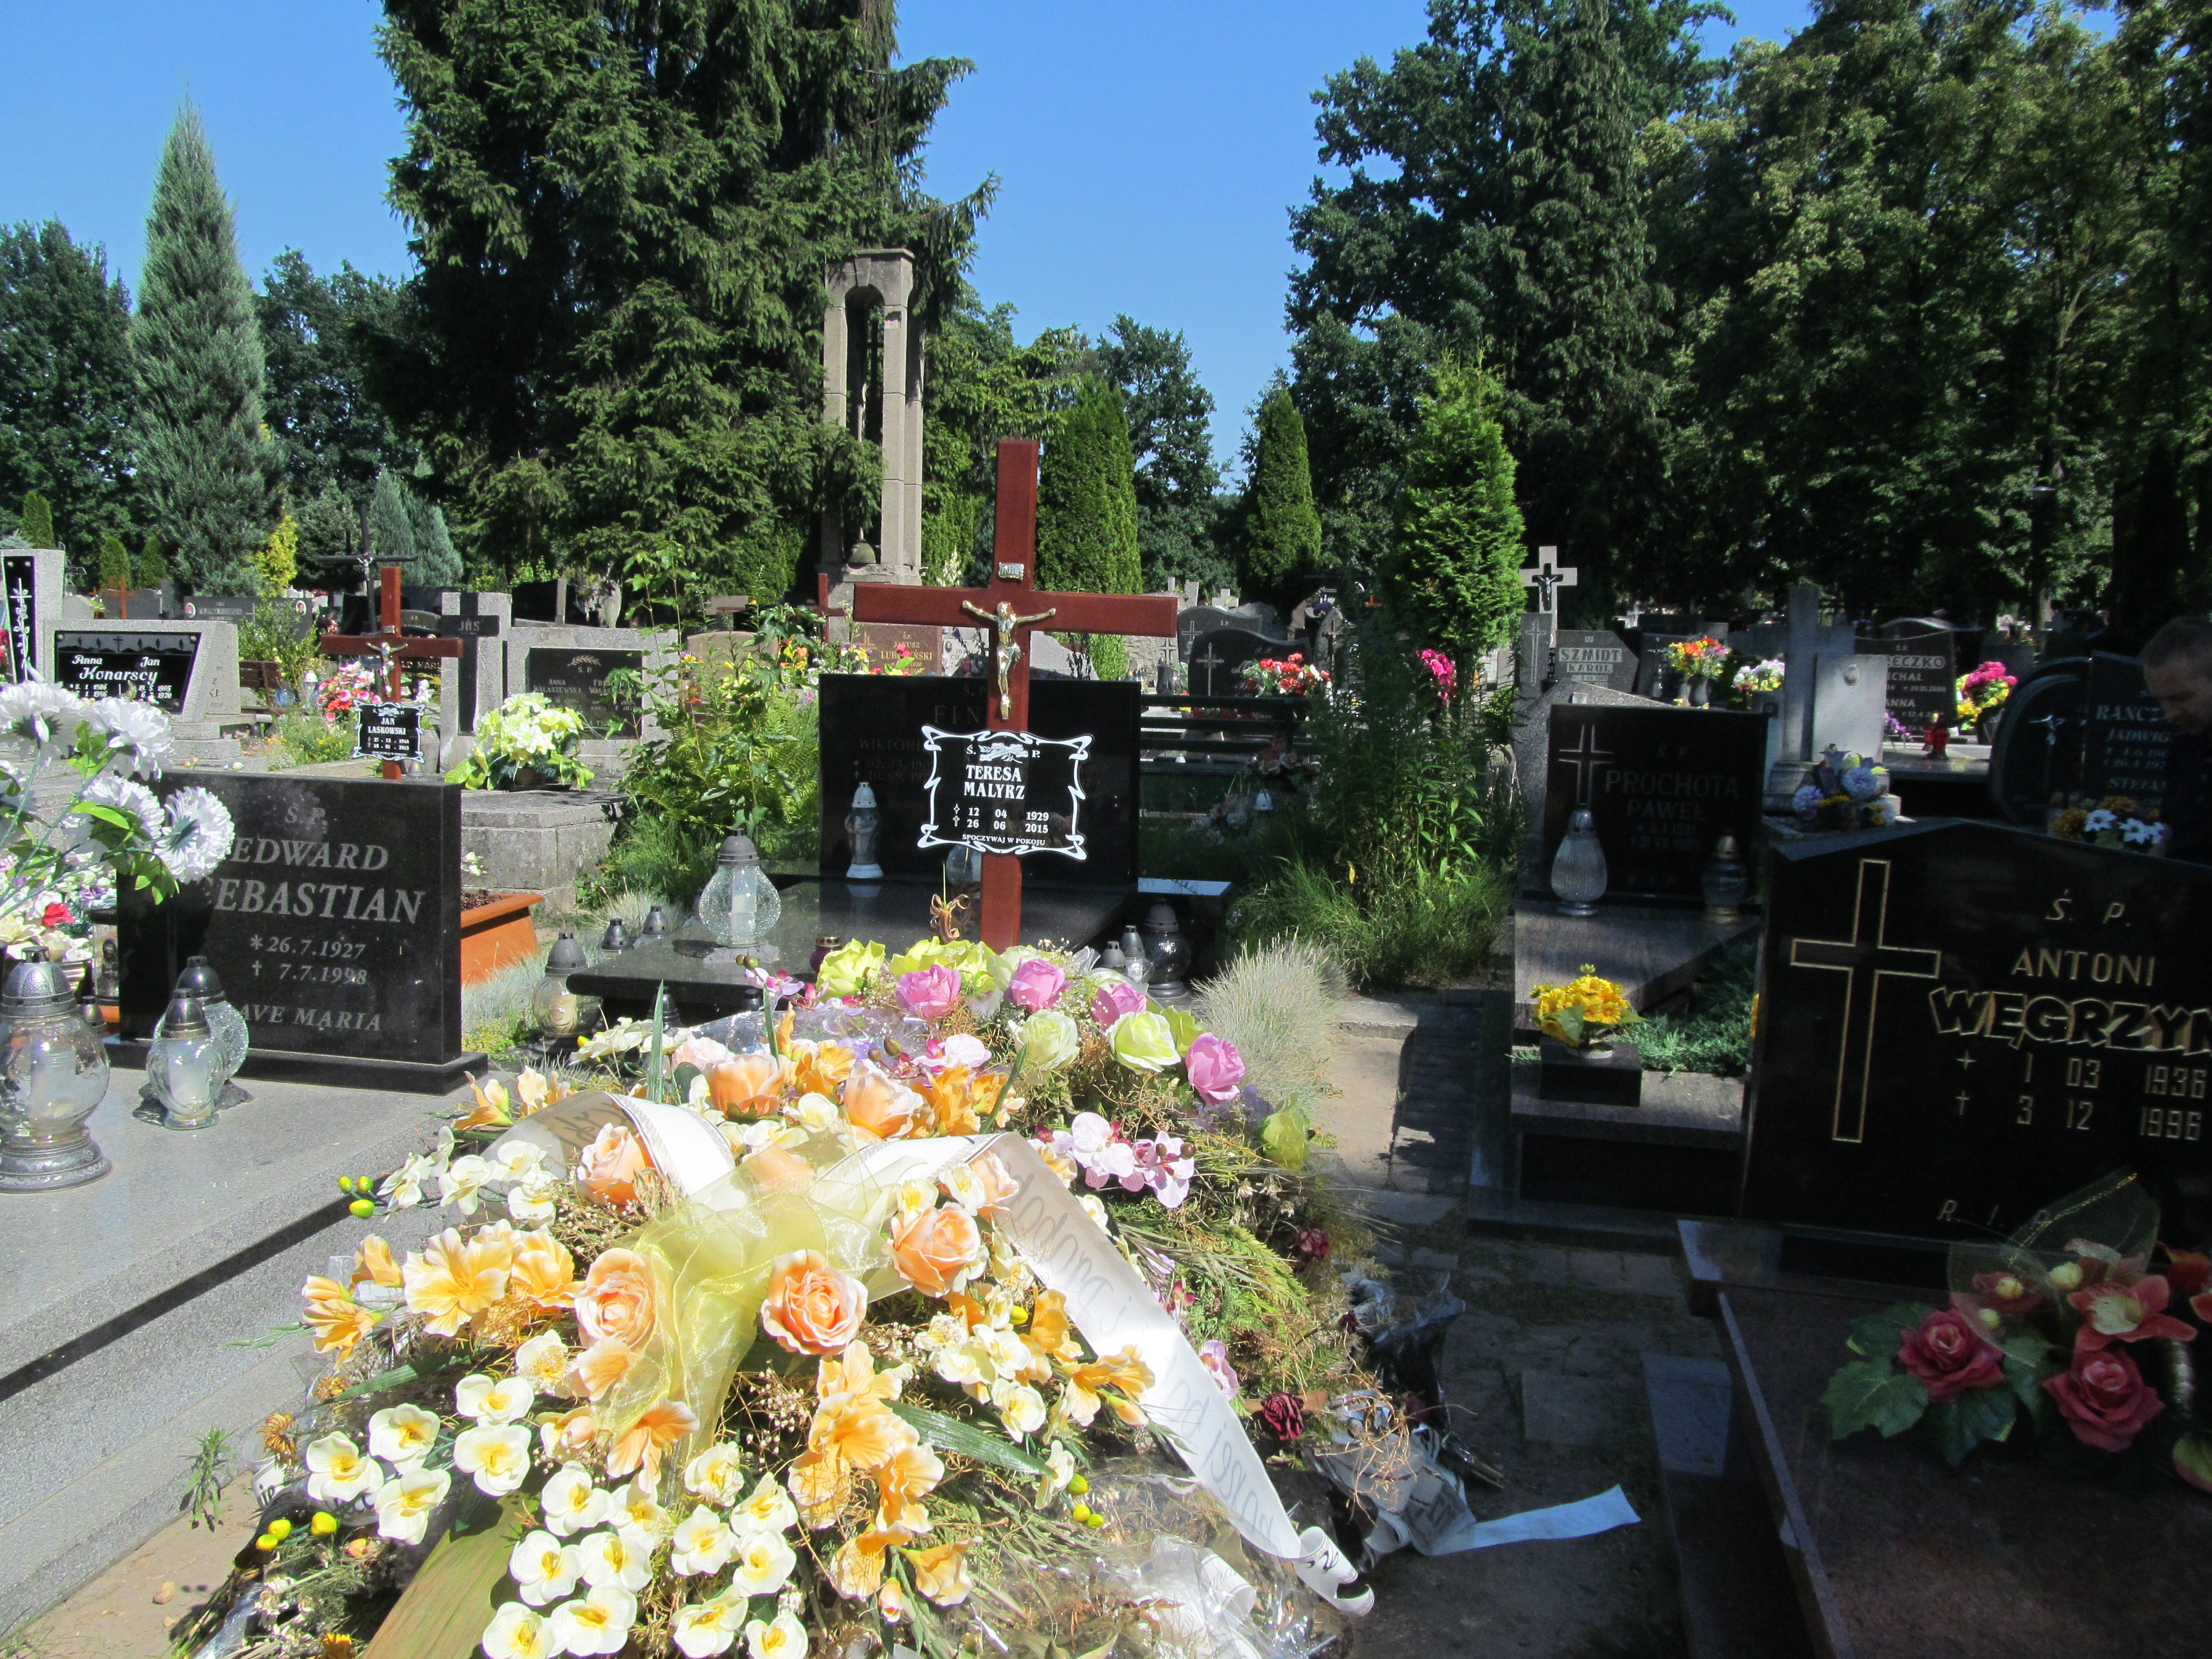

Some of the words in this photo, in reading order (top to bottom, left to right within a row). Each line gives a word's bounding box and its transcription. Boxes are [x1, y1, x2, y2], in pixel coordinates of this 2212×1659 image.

[72, 654, 103, 665] Anna
[140, 656, 160, 667] Jan
[79, 666, 159, 685] Konarscy
[380, 717, 395, 726] JAN
[934, 705, 980, 724] FIN
[859, 738, 921, 752] WIKTORI
[2105, 728, 2173, 743] JADWIG
[966, 745, 976, 755] Ś.
[1032, 750, 1040, 758] P.
[965, 764, 1022, 782] TERESA
[963, 781, 1026, 800] MALYRZ
[1605, 770, 1738, 799] PROCHOTA
[968, 807, 980, 817] 12
[995, 809, 1008, 818] 04
[1026, 811, 1049, 821] 1929
[967, 819, 980, 828] 26
[993, 820, 1006, 831] 06
[1025, 823, 1049, 834] 2015
[962, 834, 1006, 844] SPOCZYWAJ
[1015, 838, 1046, 846] POKOJU
[230, 837, 389, 871] EDWARD
[2103, 902, 2132, 926] P.
[266, 936, 367, 960] 26.7.1927
[2011, 947, 2156, 986] ANTONI
[240, 1003, 285, 1023] AVE
[292, 1007, 382, 1031] MARIA
[2066, 1057, 2101, 1089] 03
[2144, 1064, 2207, 1099] 1936
[2016, 1094, 2034, 1125] 3
[2066, 1098, 2094, 1131] 12
[2139, 1106, 2202, 1141] 1996
